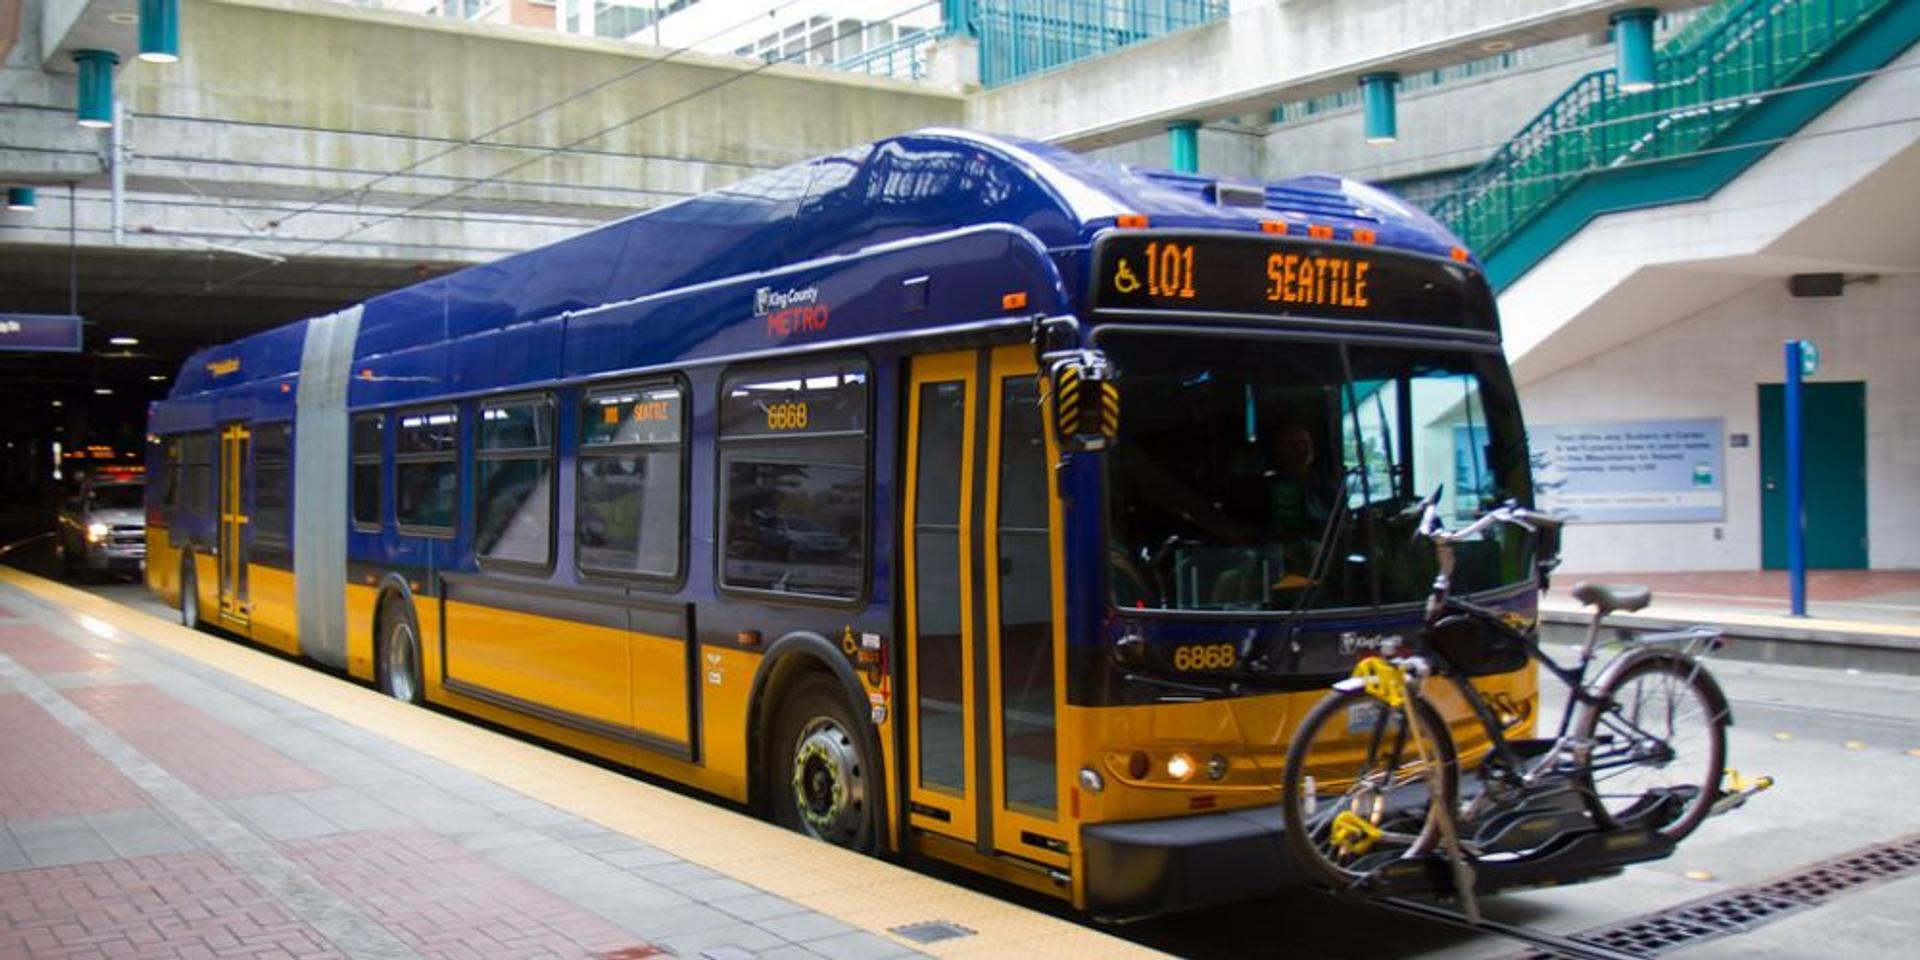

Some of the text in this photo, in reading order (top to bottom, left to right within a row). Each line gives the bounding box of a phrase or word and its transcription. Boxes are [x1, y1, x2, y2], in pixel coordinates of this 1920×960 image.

[1145, 242, 1369, 307] 101 SEATTLE
[769, 287, 819, 308] King County
[768, 304, 830, 337] METRO
[633, 401, 671, 422] SEATTLE
[1174, 644, 1234, 670] 6868
